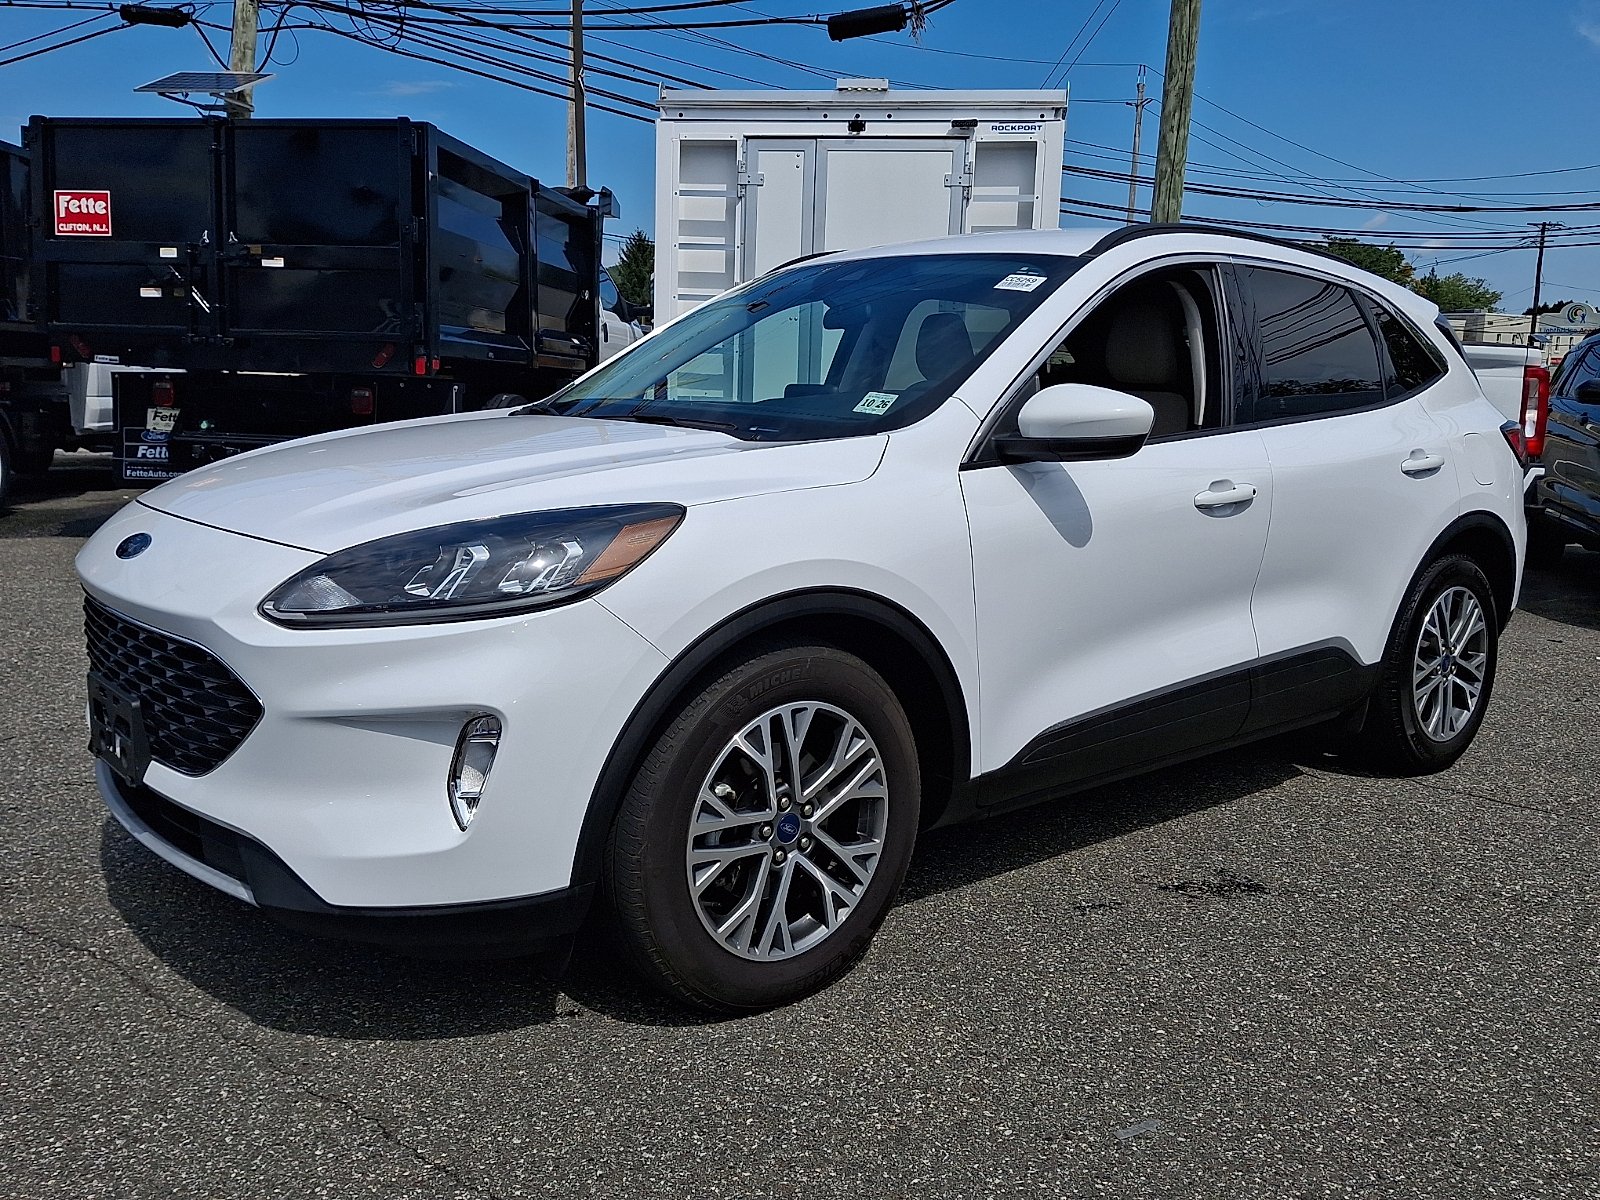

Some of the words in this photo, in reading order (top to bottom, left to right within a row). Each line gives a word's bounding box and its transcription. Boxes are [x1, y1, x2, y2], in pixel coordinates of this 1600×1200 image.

[58, 195, 107, 217] Fette
[58, 223, 92, 232] CLIFTON,
[92, 223, 108, 231] N.J.
[860, 398, 876, 408] 10
[875, 399, 891, 409] 26
[152, 410, 179, 422] Fett
[137, 445, 169, 458] Fett
